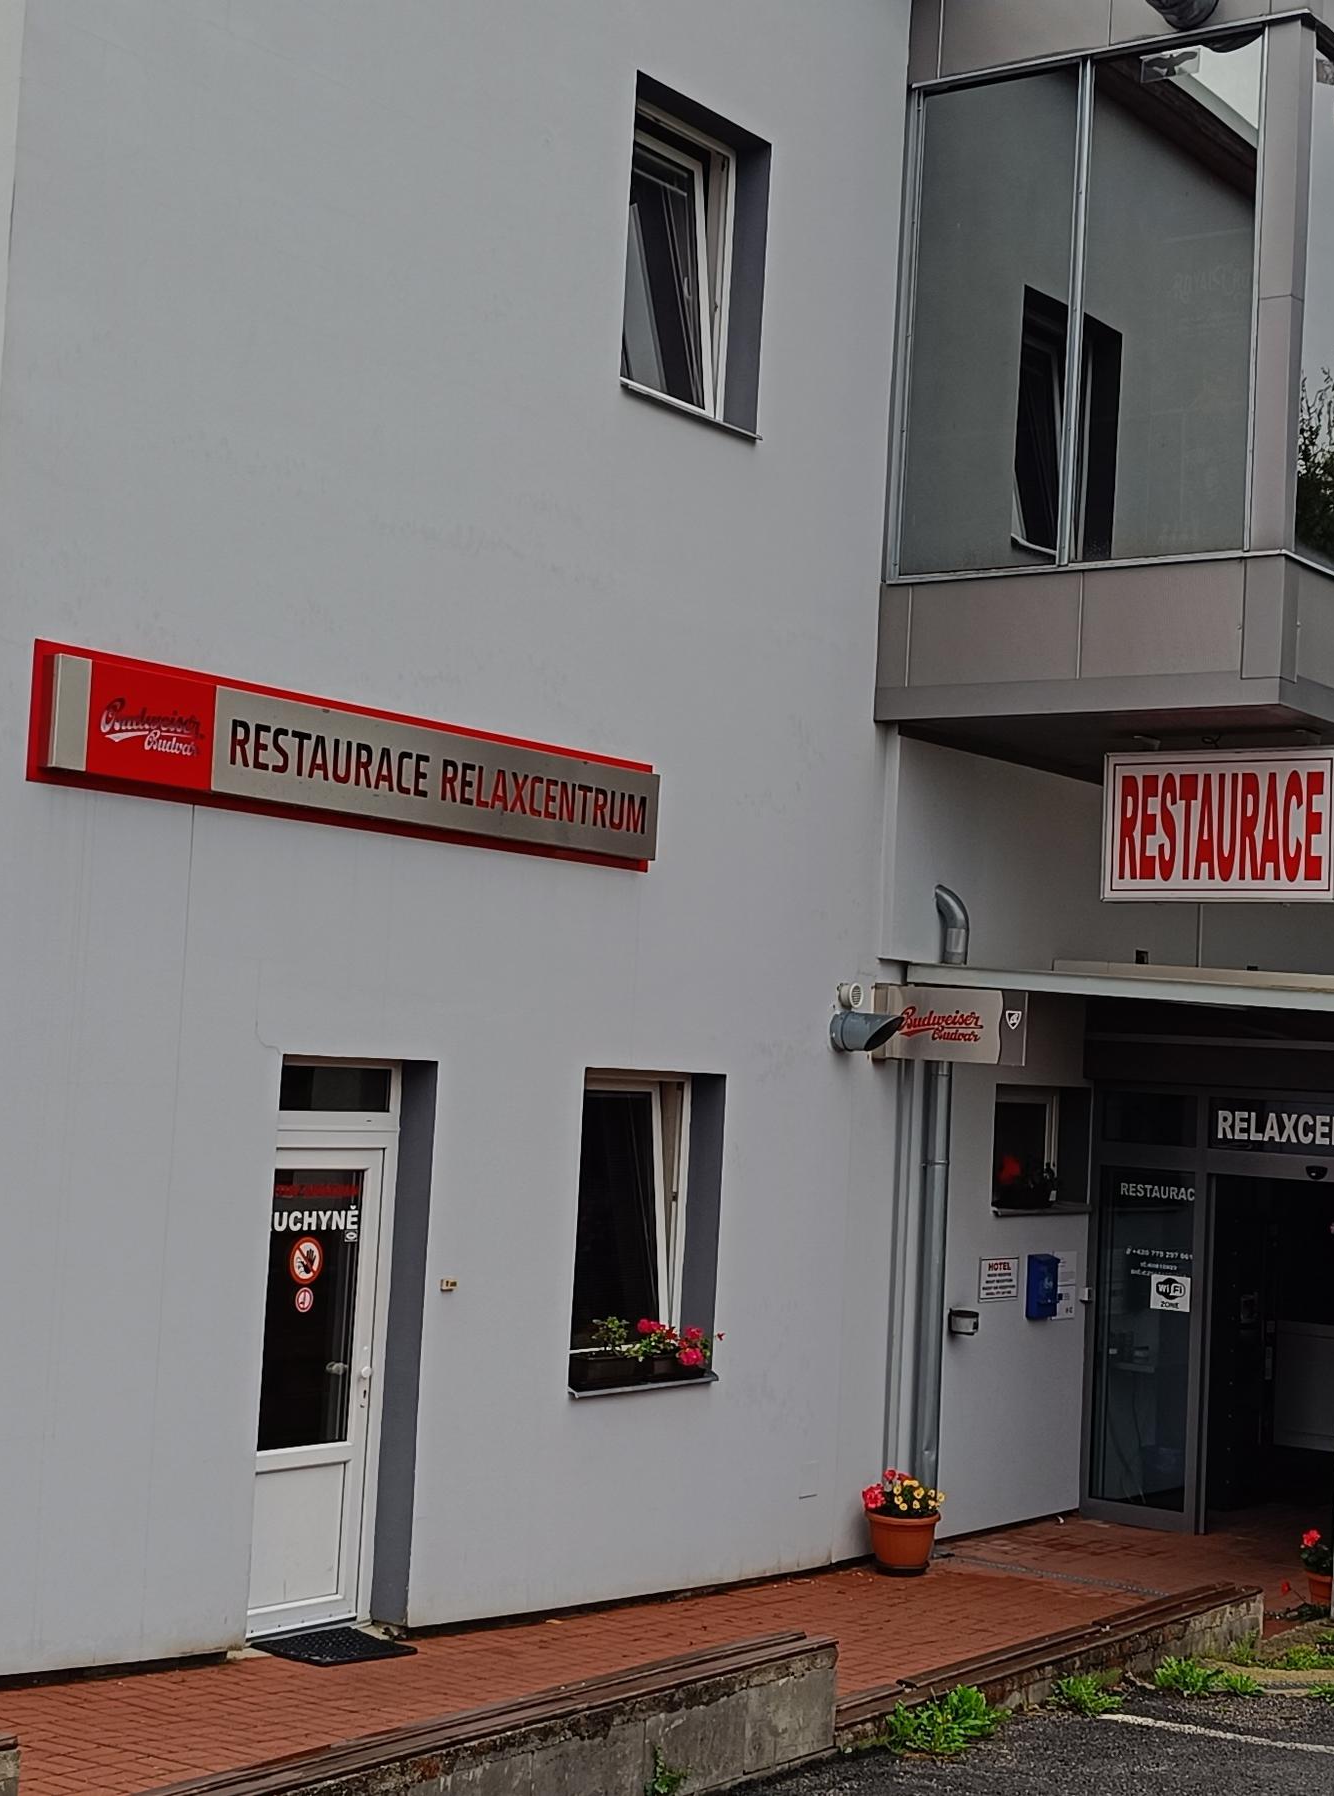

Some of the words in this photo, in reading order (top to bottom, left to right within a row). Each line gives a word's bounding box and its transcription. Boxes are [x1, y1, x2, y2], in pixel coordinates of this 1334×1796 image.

[100, 697, 203, 738] Budweiser
[229, 718, 431, 799] RESTAURACE
[441, 759, 648, 835] RELAXCENTRUM
[1119, 770, 1324, 882] RESTAURACE
[900, 1006, 983, 1029] Budweiser
[1120, 1182, 1195, 1201] RESTAURAC
[273, 1205, 359, 1232] UCHYNĚ
[988, 1262, 1011, 1271] HOTEL
